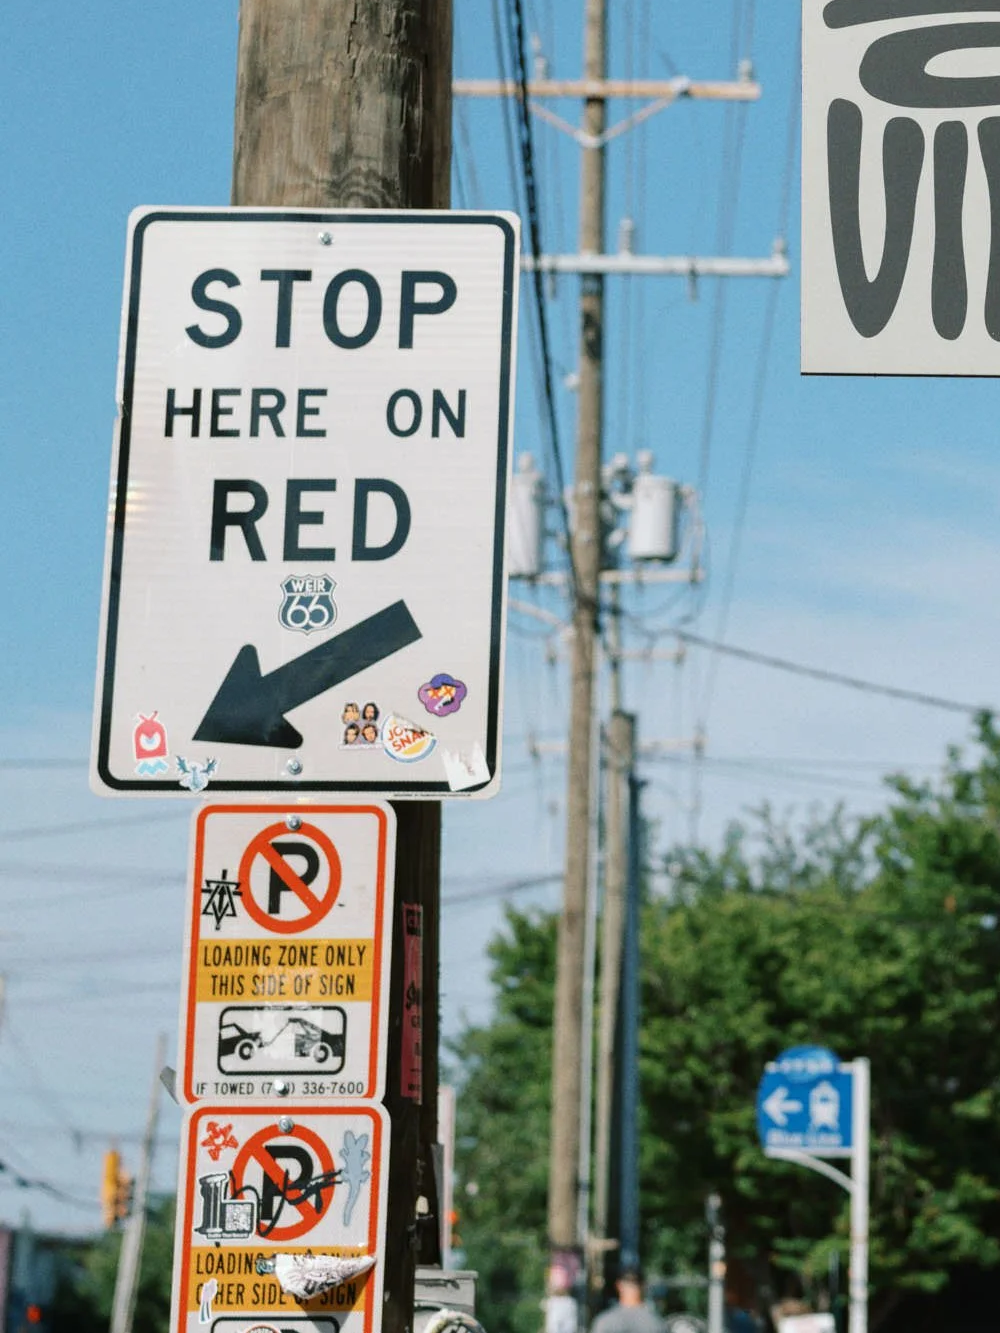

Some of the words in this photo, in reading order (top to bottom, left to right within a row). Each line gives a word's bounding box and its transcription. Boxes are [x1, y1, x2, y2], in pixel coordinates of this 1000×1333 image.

[185, 268, 458, 349] STOP
[163, 388, 328, 438] HERE
[386, 389, 467, 438] ON
[209, 479, 412, 561] RED
[291, 579, 326, 592] WEIR
[287, 595, 329, 628] 66
[204, 945, 271, 967] LOADING
[278, 945, 318, 967] ZONE
[325, 945, 367, 966] ONLY
[211, 975, 245, 996] THIS
[251, 974, 286, 996] SIDE
[294, 974, 312, 996] OF
[320, 974, 355, 995] SIGN
[196, 1082, 206, 1095] IF
[214, 1082, 254, 1095] TOWED
[261, 1081, 295, 1096] (7)
[302, 1081, 364, 1095] 336-7600
[196, 1253, 264, 1275] LOADIN
[196, 1283, 245, 1305] OHER
